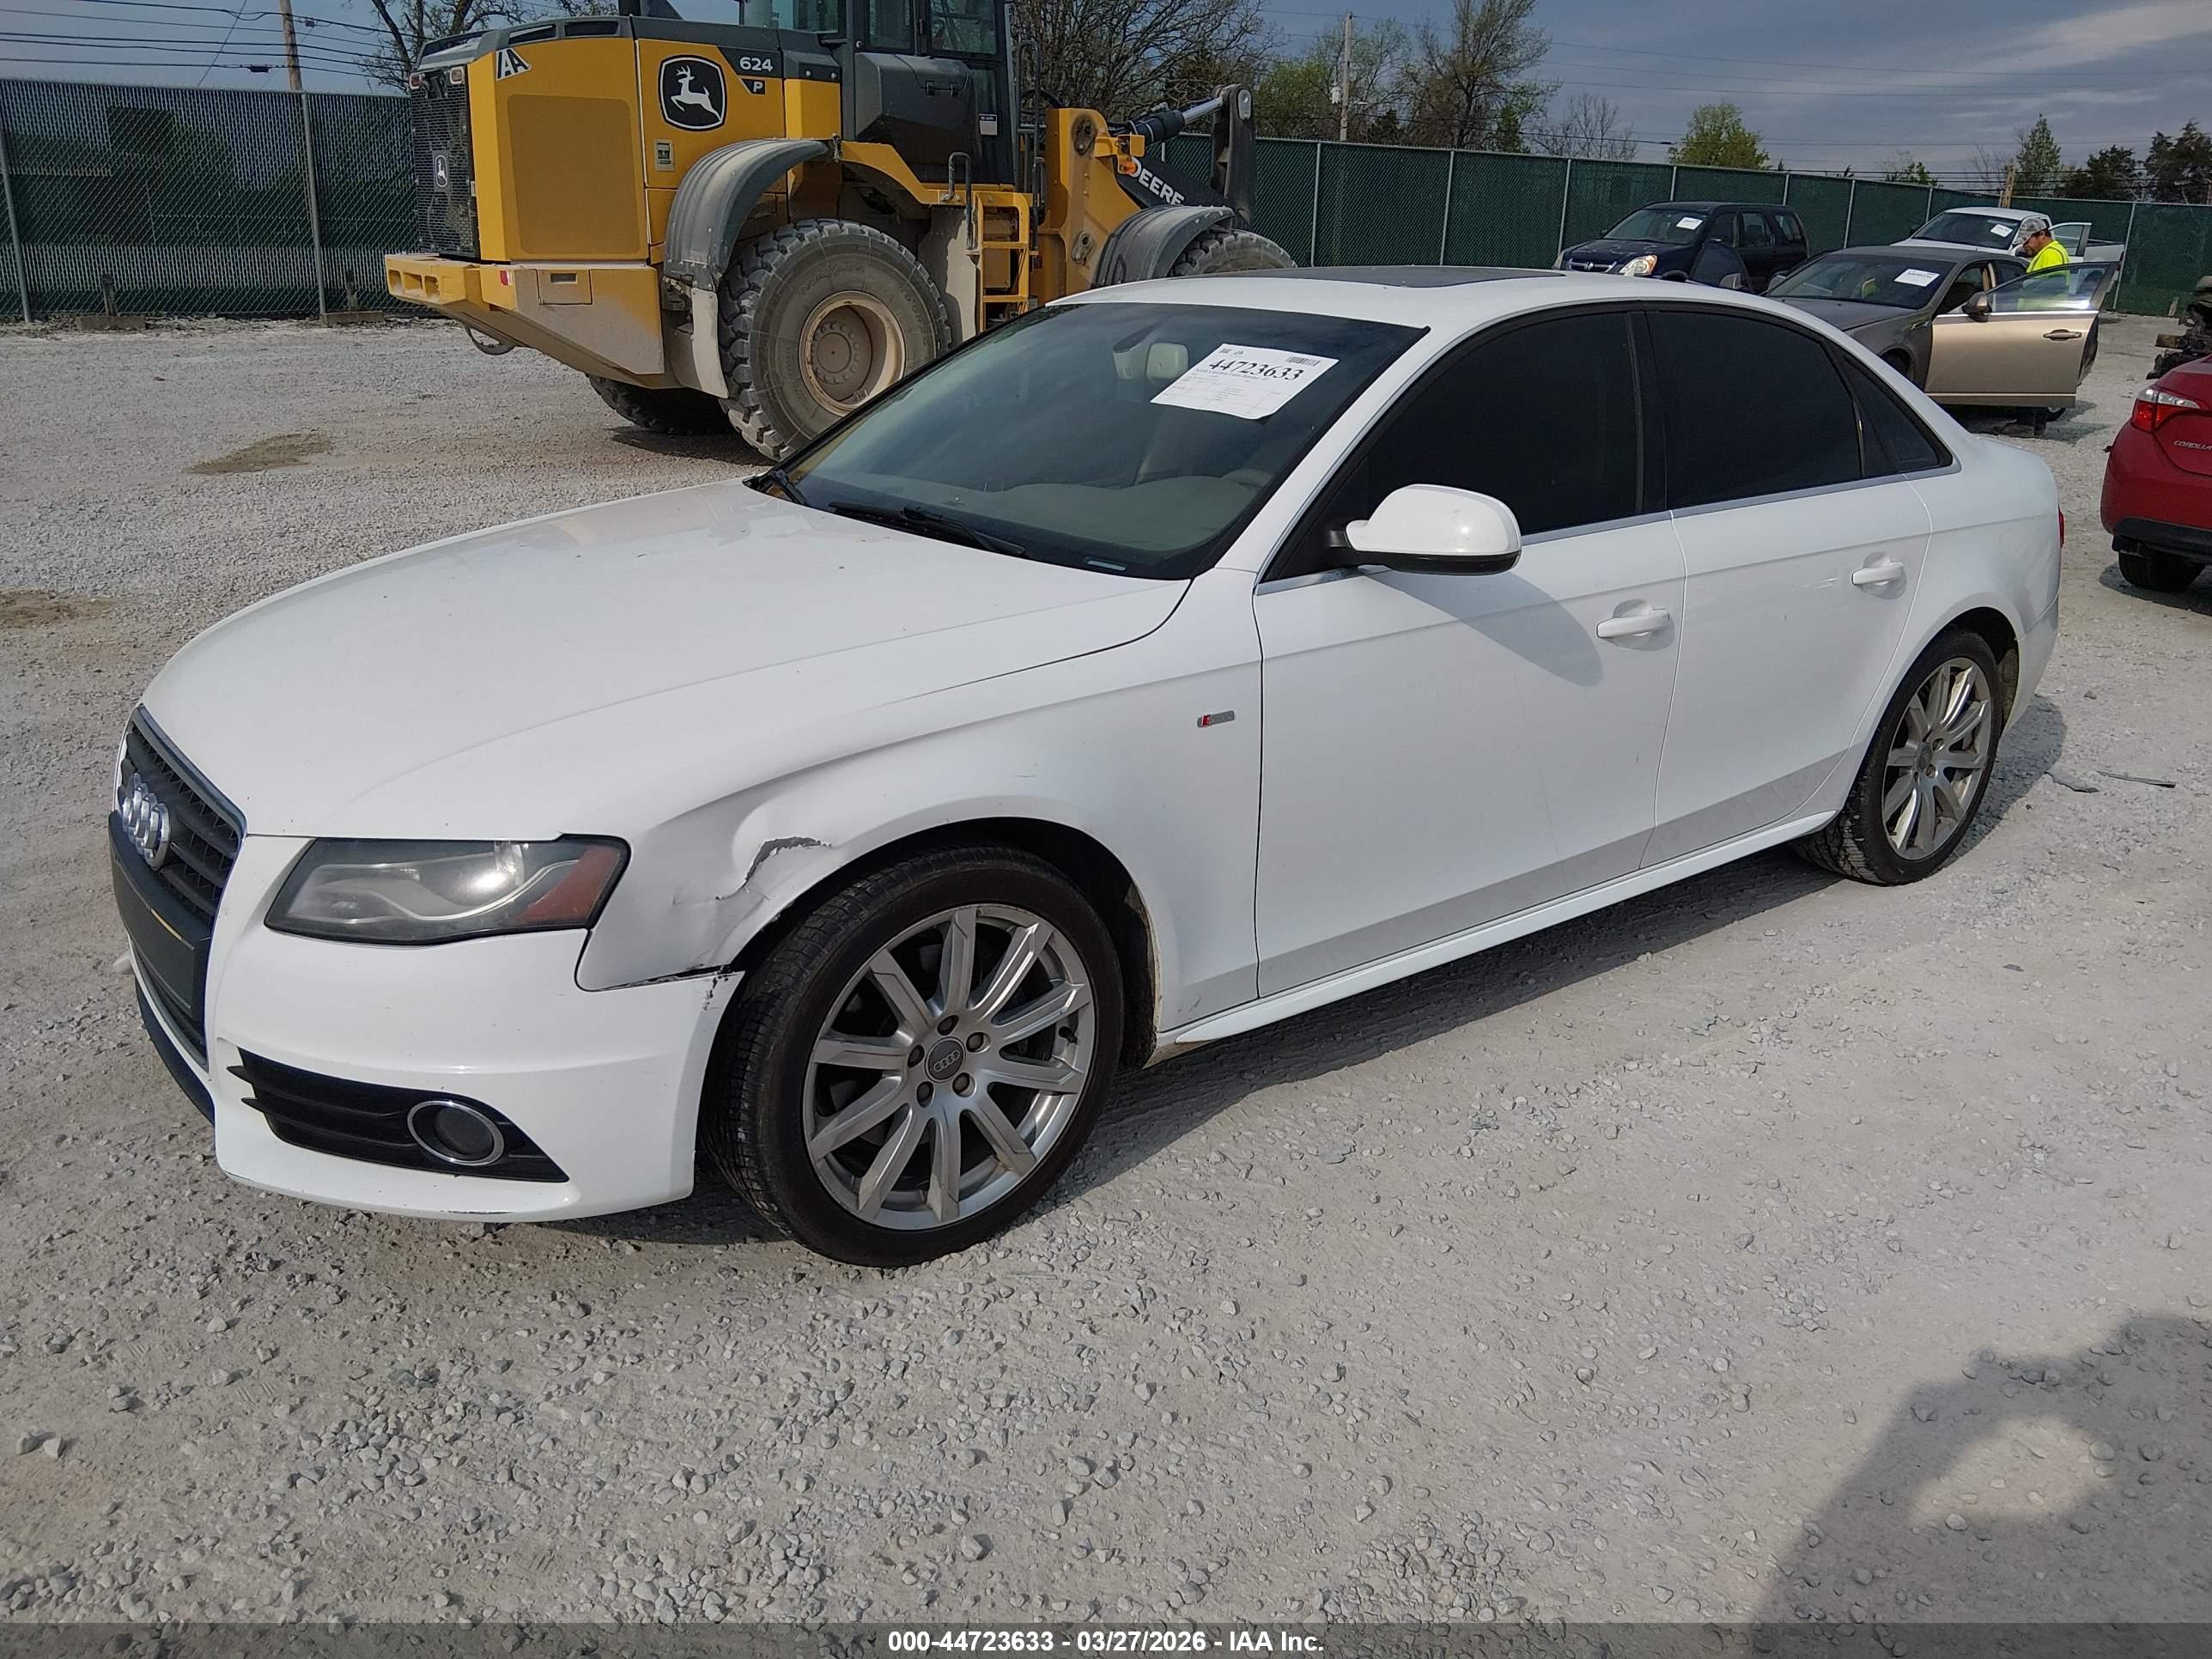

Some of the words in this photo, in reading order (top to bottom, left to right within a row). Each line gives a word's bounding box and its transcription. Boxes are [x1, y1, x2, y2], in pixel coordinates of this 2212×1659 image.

[739, 56, 774, 72] 624
[752, 81, 763, 93] P
[1209, 359, 1304, 380] 44723633
